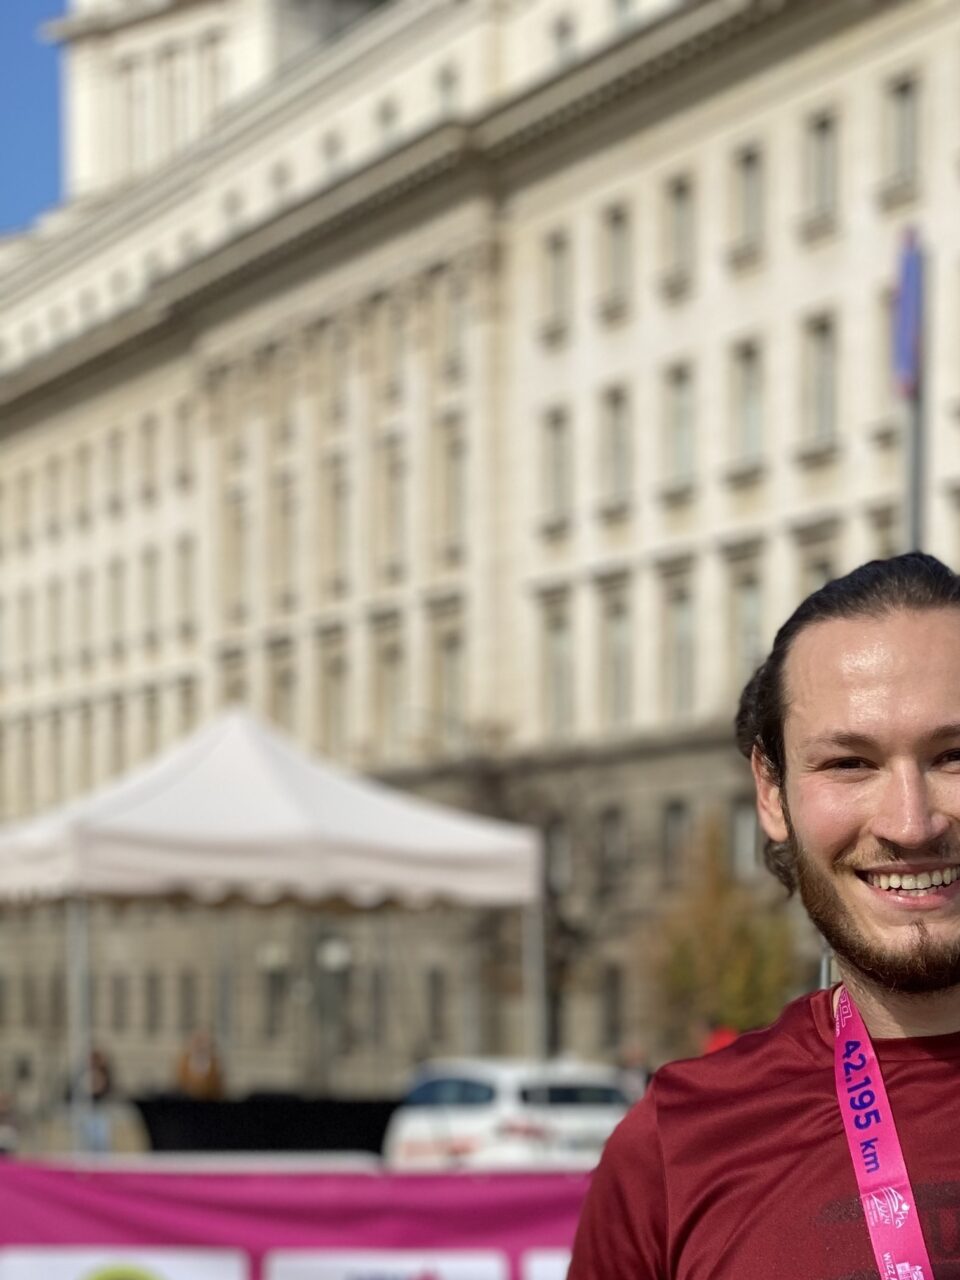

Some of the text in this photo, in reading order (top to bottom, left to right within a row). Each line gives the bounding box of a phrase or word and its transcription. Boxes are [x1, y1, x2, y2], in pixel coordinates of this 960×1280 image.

[842, 1040, 881, 1130] 42.195
[860, 1137, 880, 1174] km
[883, 1252, 896, 1275] WIZZ
